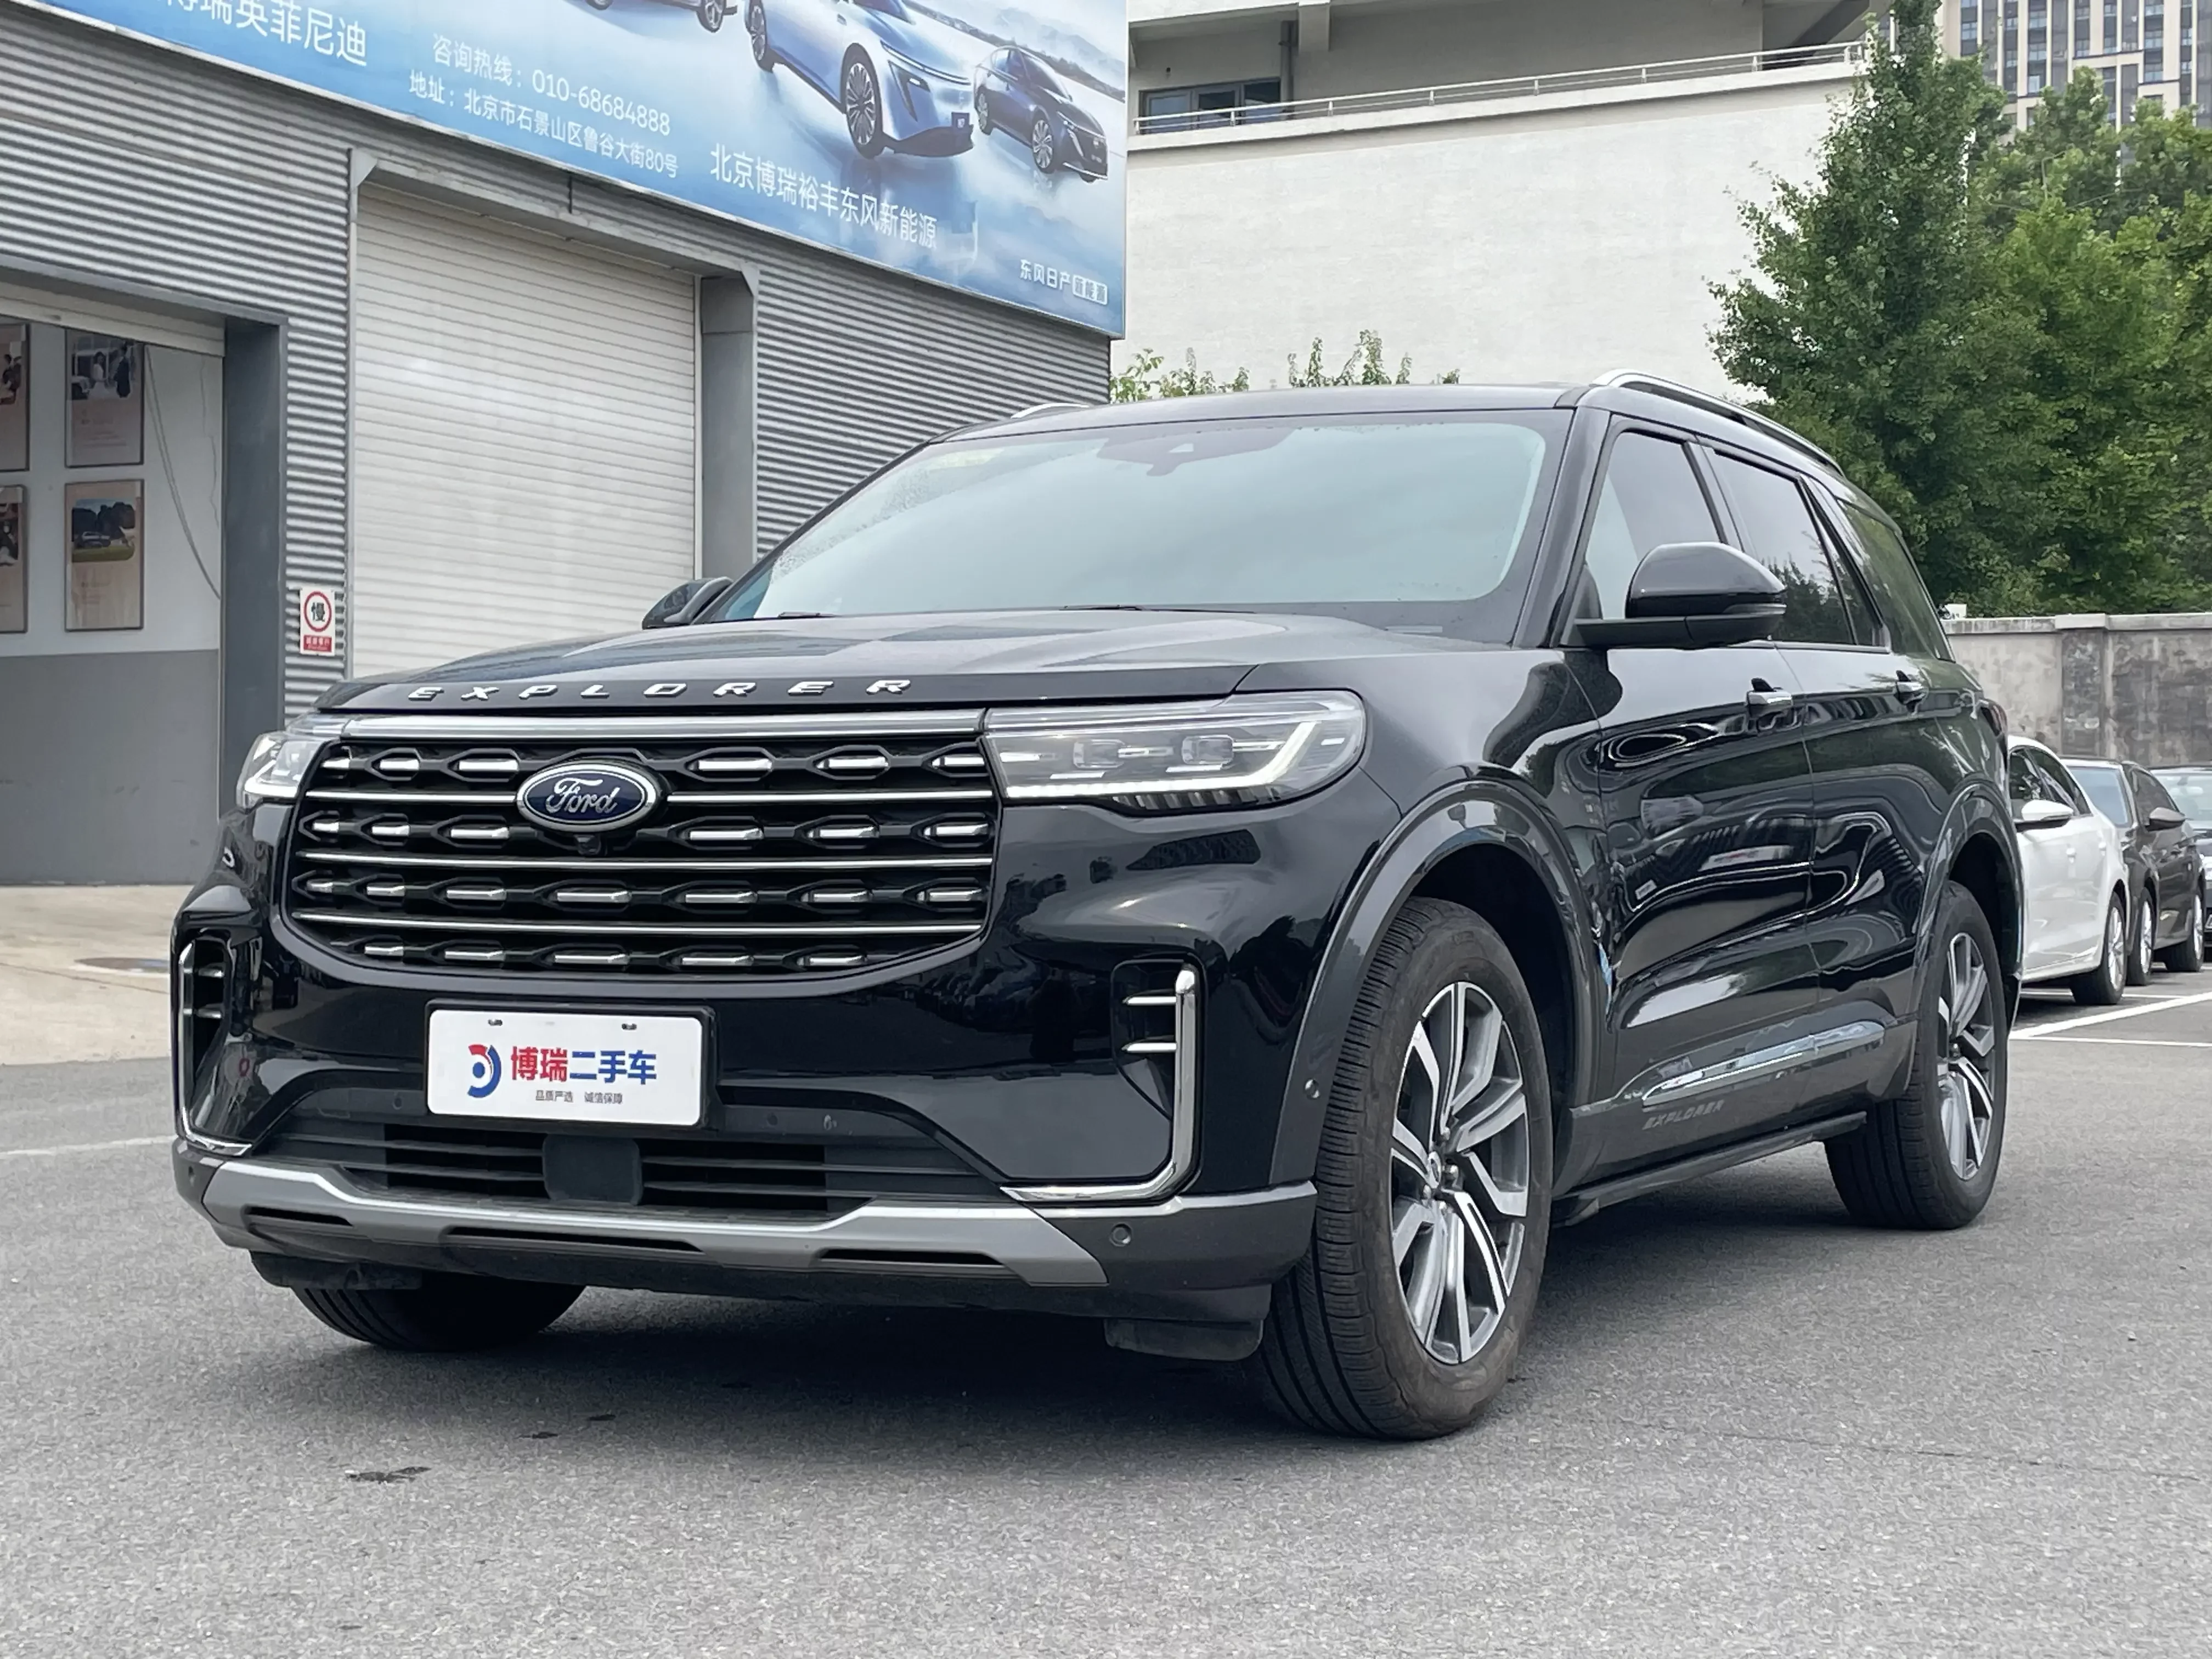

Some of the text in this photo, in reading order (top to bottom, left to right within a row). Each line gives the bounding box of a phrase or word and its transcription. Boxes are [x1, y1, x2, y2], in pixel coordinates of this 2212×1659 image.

[167, 0, 367, 66] 瑞英菲尼迪
[710, 143, 938, 251] 北京博瑞裕丰东风新能源
[408, 679, 912, 702] EXPLORER
[545, 776, 620, 815] Ford
[511, 1046, 657, 1085] 博瑞二手车
[1641, 1099, 1725, 1130] EXPLORER
